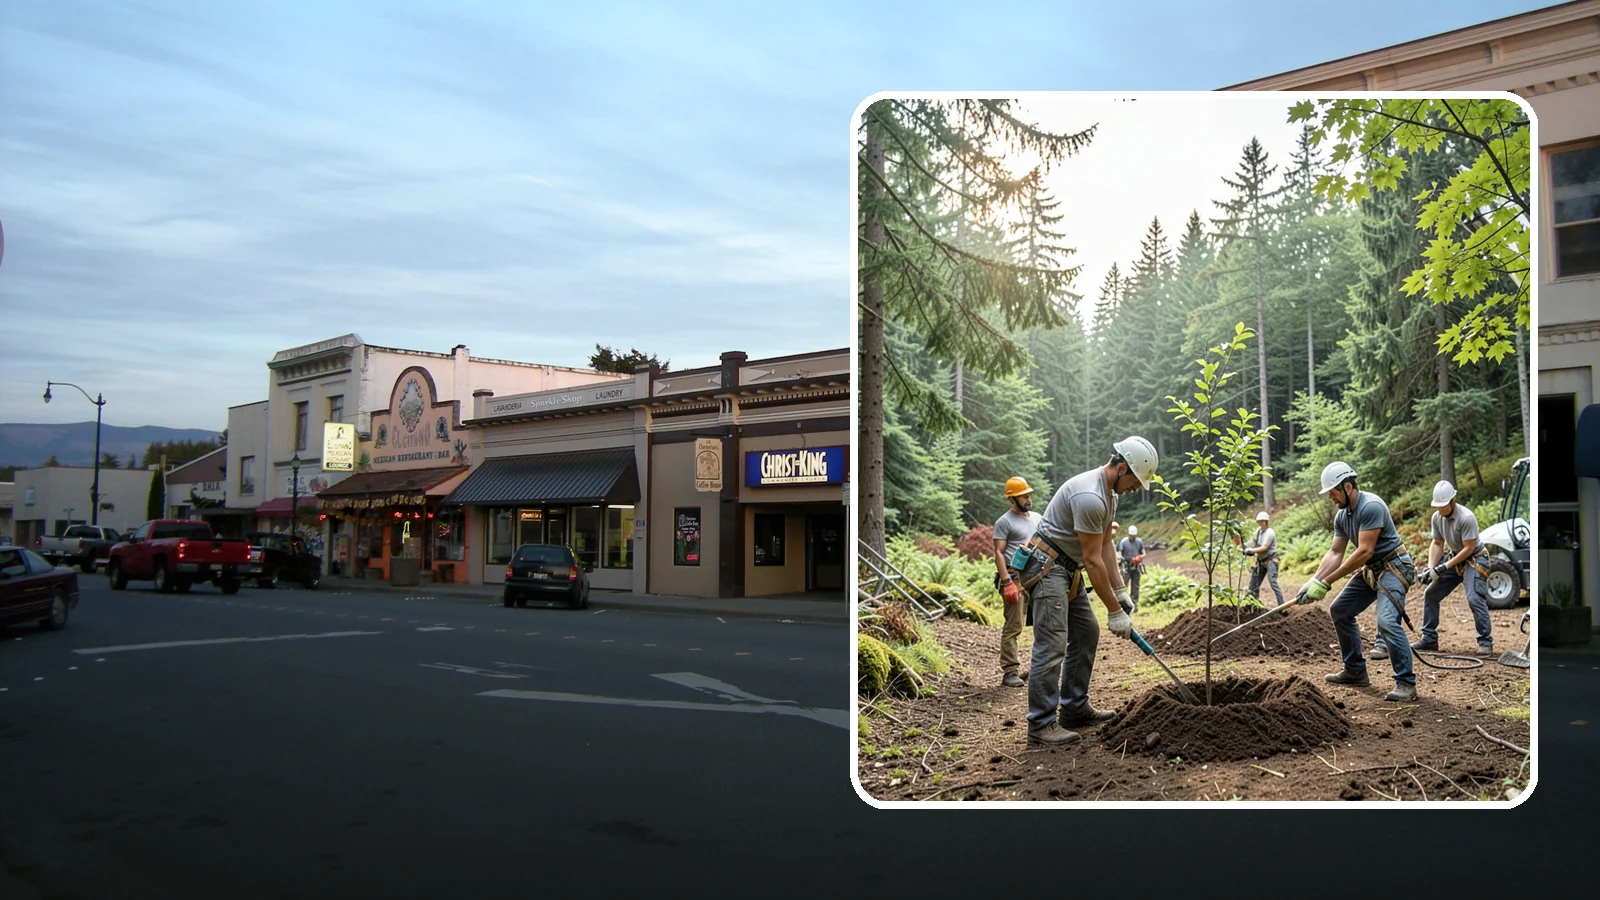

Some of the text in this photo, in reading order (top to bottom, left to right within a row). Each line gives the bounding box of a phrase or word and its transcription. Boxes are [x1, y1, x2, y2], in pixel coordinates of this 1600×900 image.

[493, 402, 522, 413] LAVANDERIA
[562, 394, 582, 405] Shop
[595, 388, 623, 400] LAUNDRY
[398, 451, 433, 462] RESTAURANT
[438, 450, 450, 459] BAR
